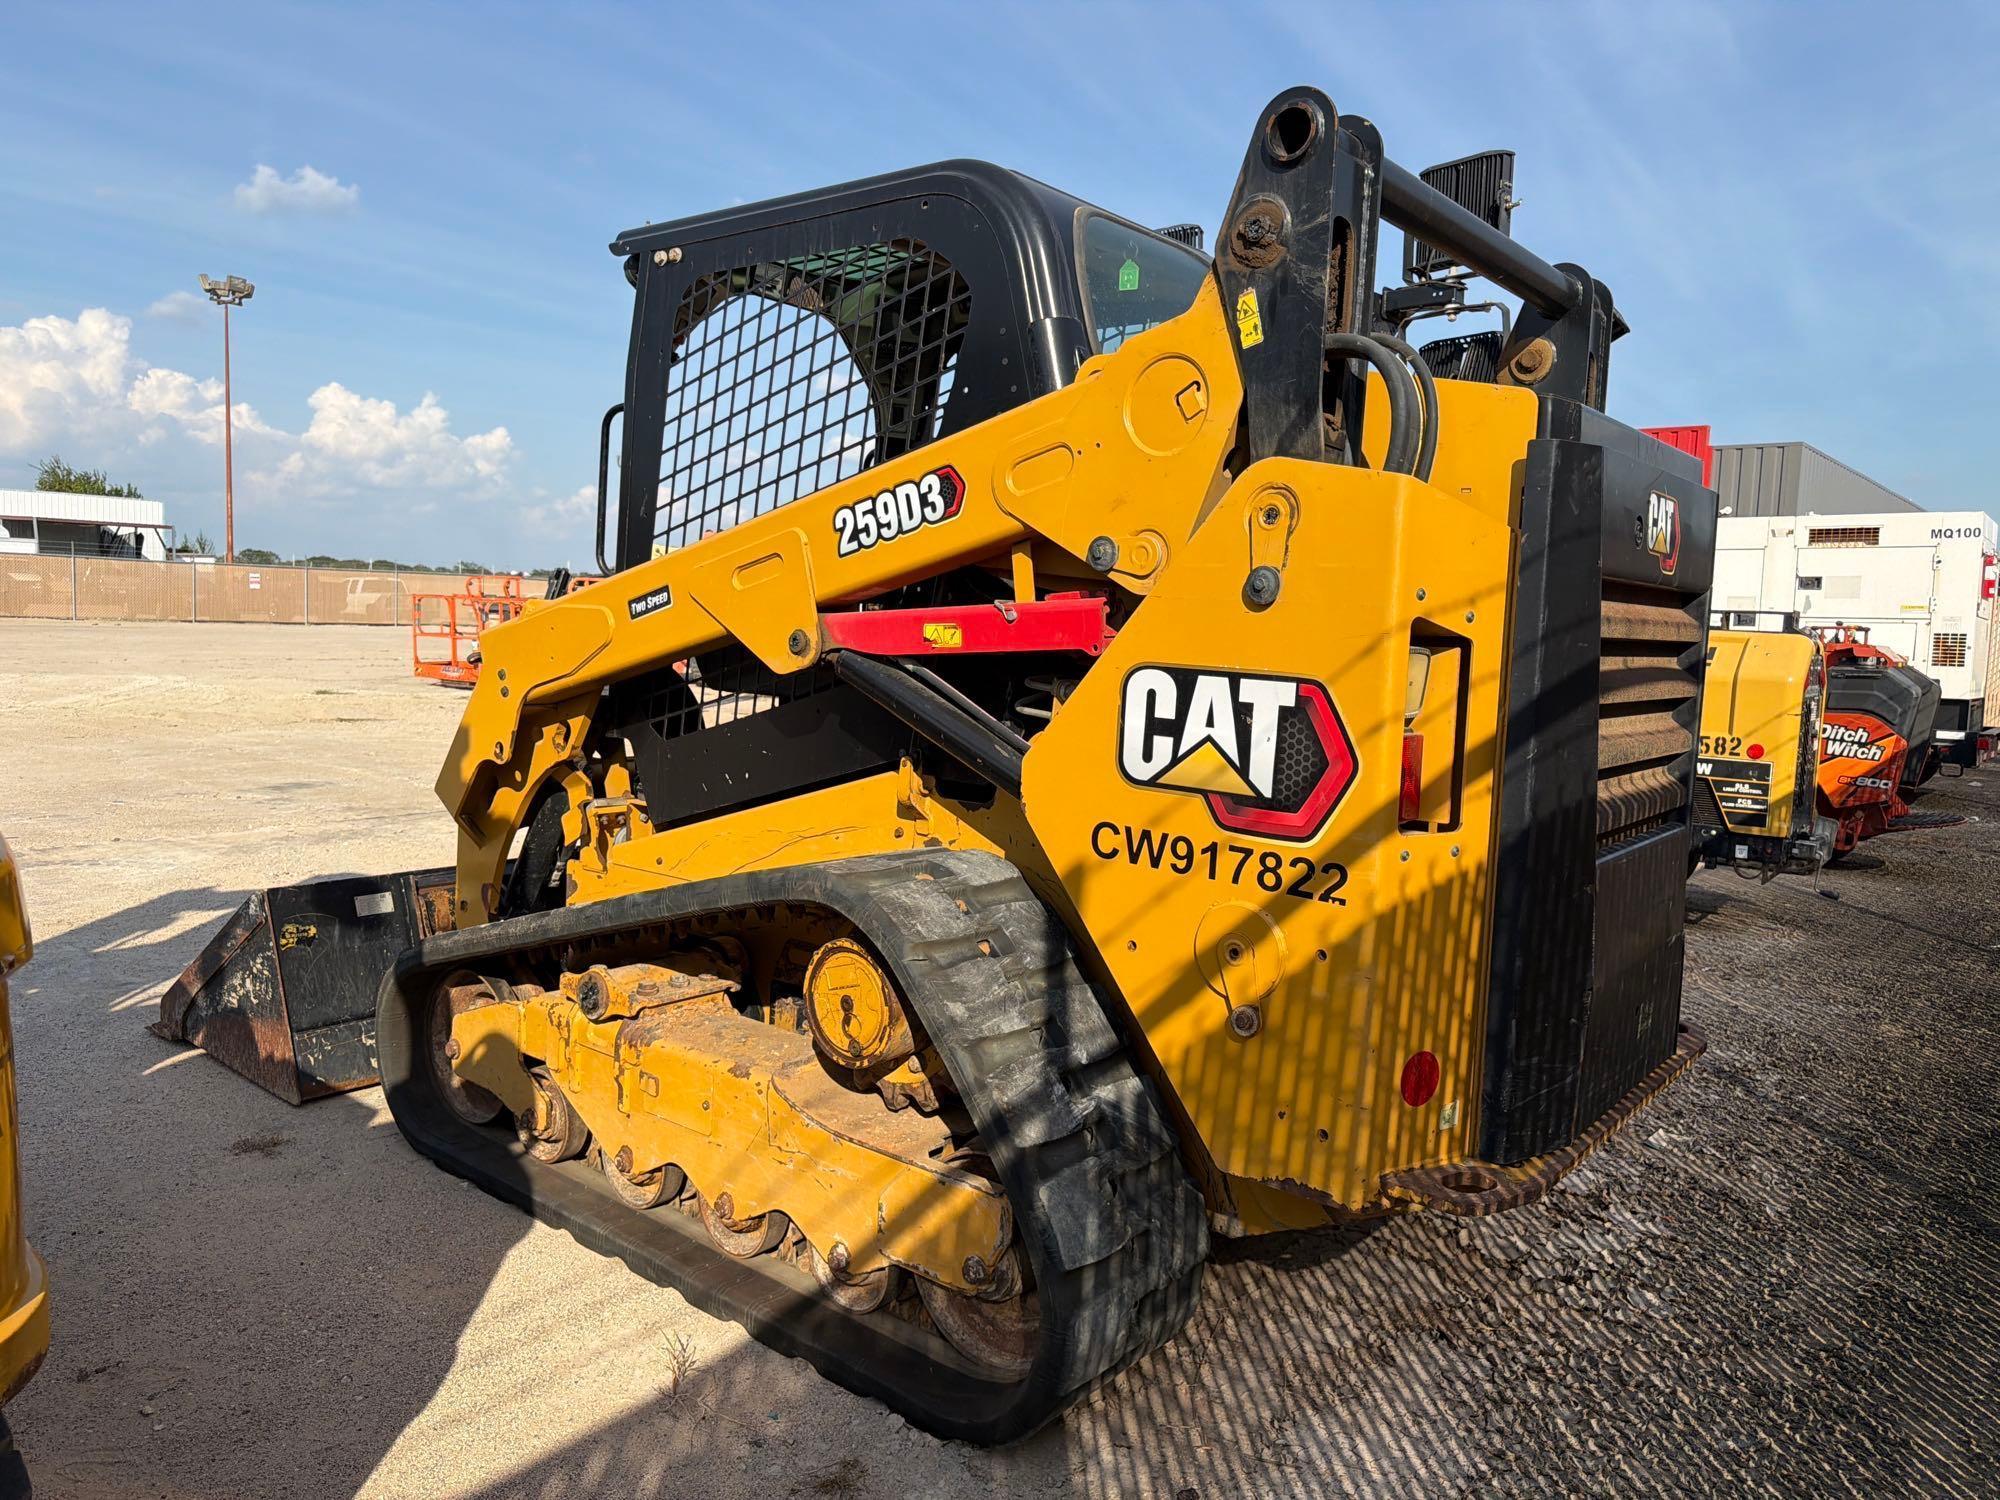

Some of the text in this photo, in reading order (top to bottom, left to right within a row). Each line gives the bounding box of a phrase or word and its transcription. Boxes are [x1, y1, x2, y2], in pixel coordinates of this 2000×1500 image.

[835, 473, 945, 555] 259D3
[1648, 493, 1674, 554] CAT
[1930, 527, 1981, 539] MQ100
[1121, 668, 1297, 799] CAT
[1821, 723, 1869, 743] Ditch
[1826, 740, 1882, 761] Witch
[1091, 821, 1349, 907] CW917822
